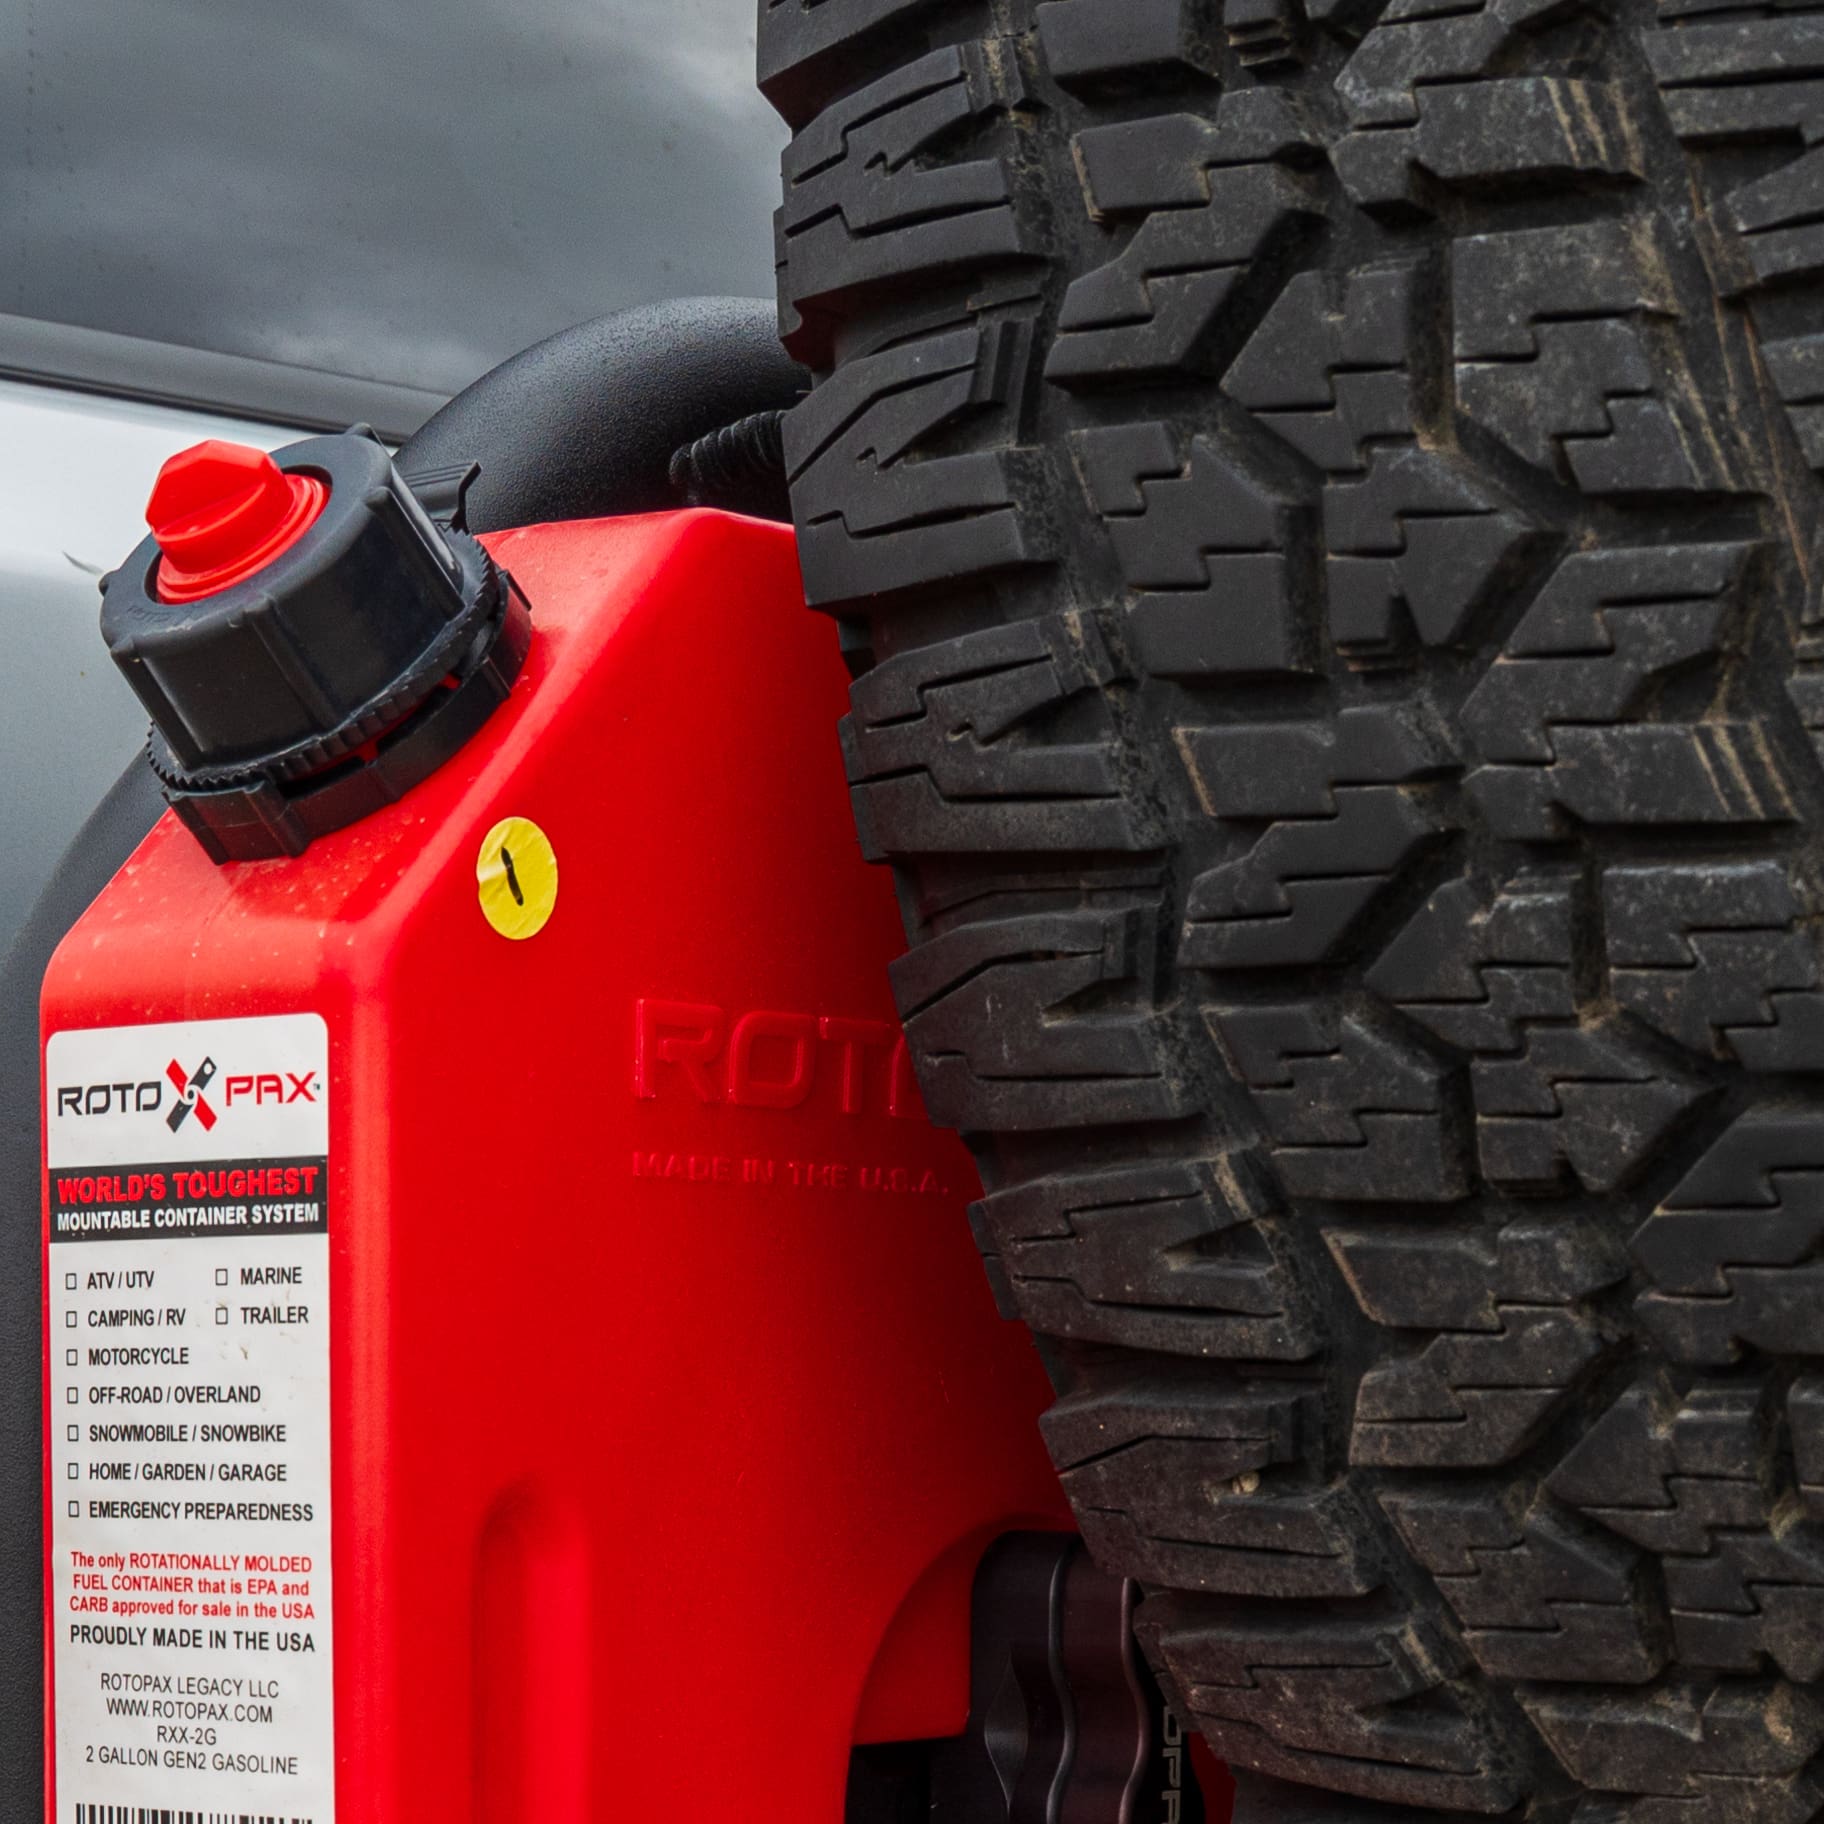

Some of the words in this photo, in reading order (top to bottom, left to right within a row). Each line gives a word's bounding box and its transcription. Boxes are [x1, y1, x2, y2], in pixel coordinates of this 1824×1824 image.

[57, 1081, 162, 1116] ROTO
[633, 1151, 731, 1183] MADE
[742, 1157, 775, 1185] IN
[786, 1160, 849, 1188] THE
[57, 1173, 166, 1205] WORLD'S
[172, 1166, 319, 1200] TOUGHEST
[57, 1208, 151, 1231] MOUNTABLE
[154, 1205, 247, 1227] CONTAINER
[250, 1202, 320, 1224] SYSTEM
[87, 1272, 114, 1290] ATV
[125, 1271, 154, 1288] UTV
[240, 1266, 303, 1285] MARINE
[87, 1309, 155, 1327] CAMPING
[166, 1308, 186, 1326] RV
[240, 1306, 309, 1325] TRAILER
[88, 1347, 190, 1366] MOTORCYCLE
[88, 1386, 163, 1404] OFF-ROAD
[174, 1385, 261, 1403] OVERLAND
[88, 1425, 188, 1442] SNOWMOBILE
[200, 1424, 287, 1442] SNOWBIKE
[88, 1462, 132, 1480] HOME
[142, 1463, 206, 1481] GARDEN
[218, 1463, 287, 1482] GARAGE
[88, 1500, 180, 1519] EMERGENCY
[184, 1502, 314, 1522] PREPAREDNESS
[71, 1551, 94, 1568] The
[98, 1553, 125, 1572] only
[129, 1553, 240, 1572] ROTATIONALLY
[244, 1555, 312, 1573] MOLDED
[73, 1573, 108, 1591] FUEL
[111, 1575, 194, 1594] CONTAINER
[198, 1577, 227, 1594] that
[230, 1578, 242, 1594] is
[247, 1579, 277, 1595] EPA
[282, 1580, 309, 1596] and
[69, 1596, 108, 1613] CARB
[112, 1598, 174, 1617] approved
[178, 1599, 198, 1616] for
[202, 1600, 231, 1617] sale
[236, 1601, 249, 1617] in
[254, 1602, 277, 1618] the
[281, 1602, 315, 1619] USA
[70, 1624, 147, 1647] PROUDLY
[152, 1627, 202, 1649] MADE
[209, 1630, 226, 1649] IN
[233, 1630, 269, 1651] THE
[277, 1632, 315, 1652] USA
[100, 1672, 172, 1694] ROTOPAX
[177, 1676, 243, 1697] LEGACY
[248, 1679, 279, 1699] LLC
[105, 1697, 273, 1723] WWW.ROTOPAX.COM
[157, 1725, 217, 1746] RXX-2G
[85, 1745, 94, 1763] 2
[98, 1746, 158, 1767] GALLON
[163, 1750, 206, 1770] GEN2
[212, 1753, 298, 1775] GASOLINE
